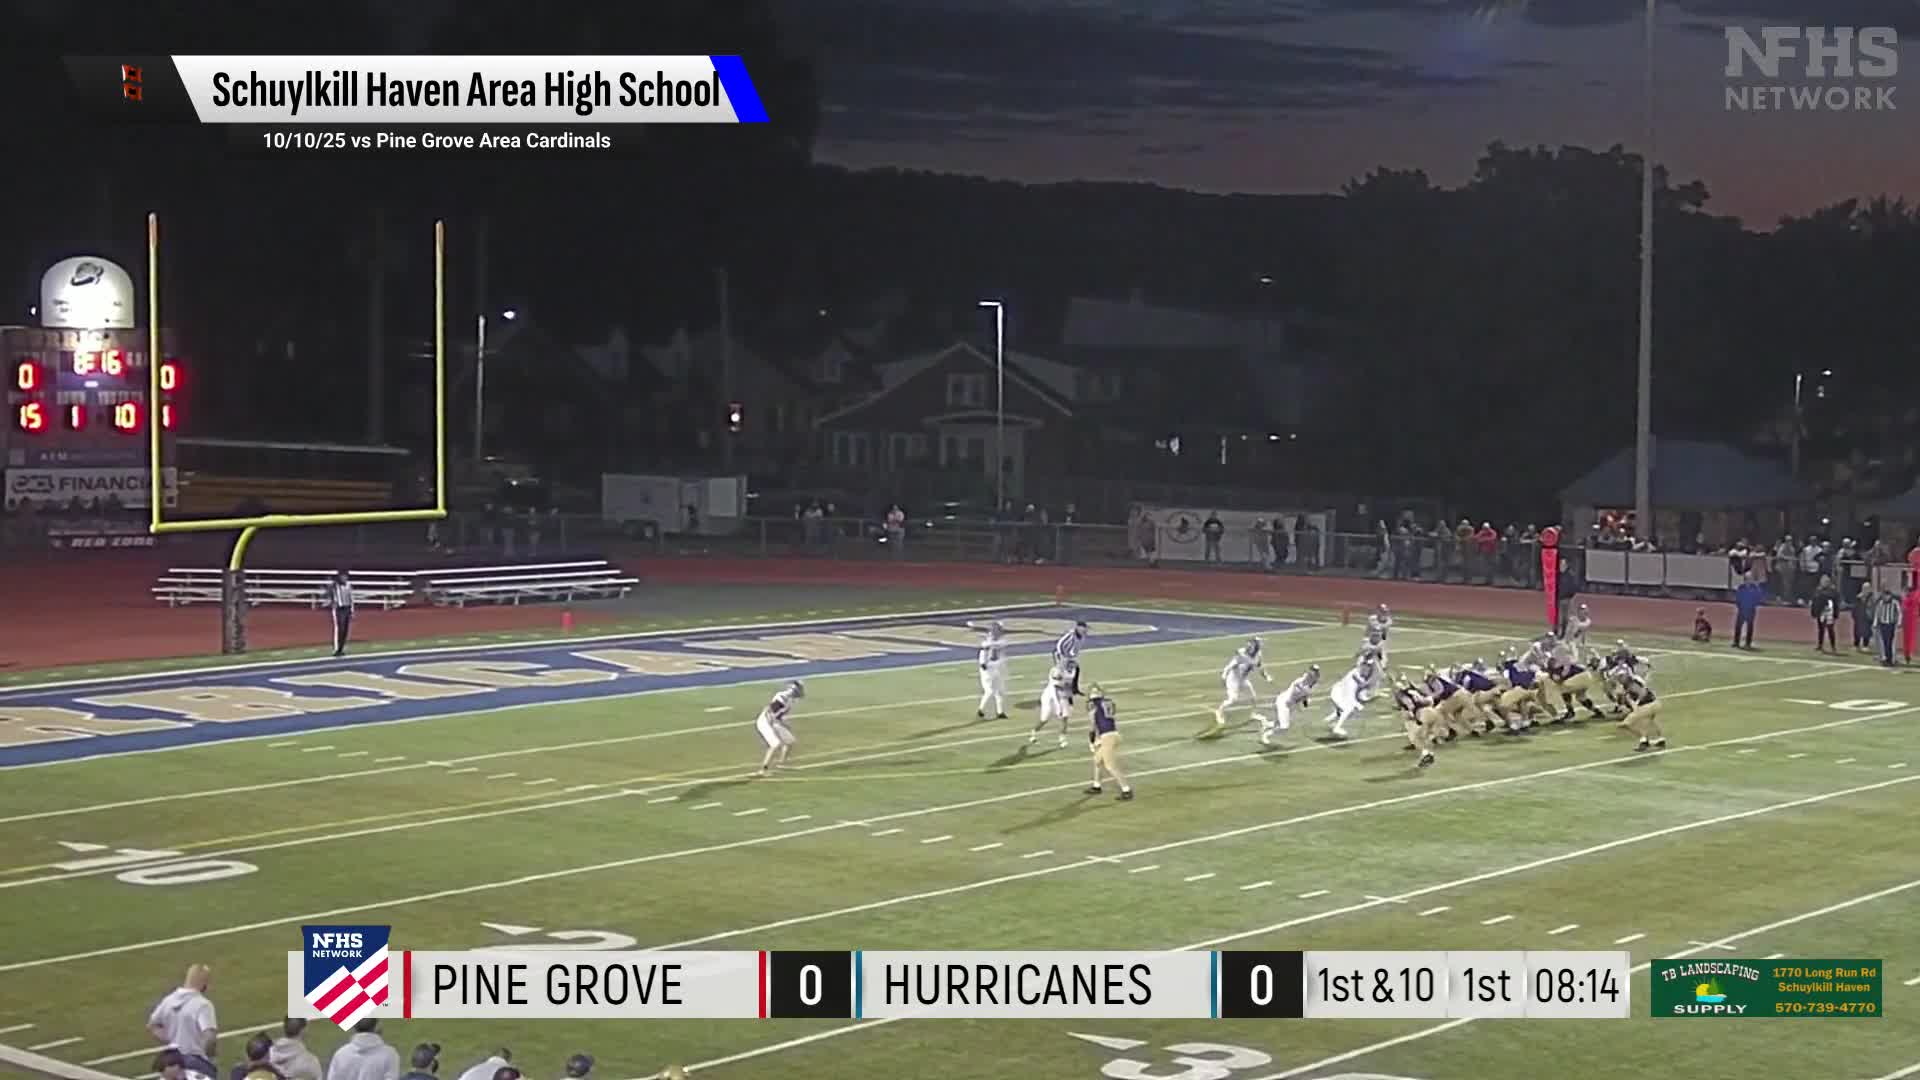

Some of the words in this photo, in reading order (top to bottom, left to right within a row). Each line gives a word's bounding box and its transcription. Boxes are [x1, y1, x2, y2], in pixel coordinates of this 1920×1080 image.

[18, 364, 33, 389] 0
[160, 365, 175, 390] 0
[20, 403, 42, 428] 15
[71, 405, 80, 427] 1
[115, 403, 137, 428] 10
[59, 476, 173, 491] FINANCIL
